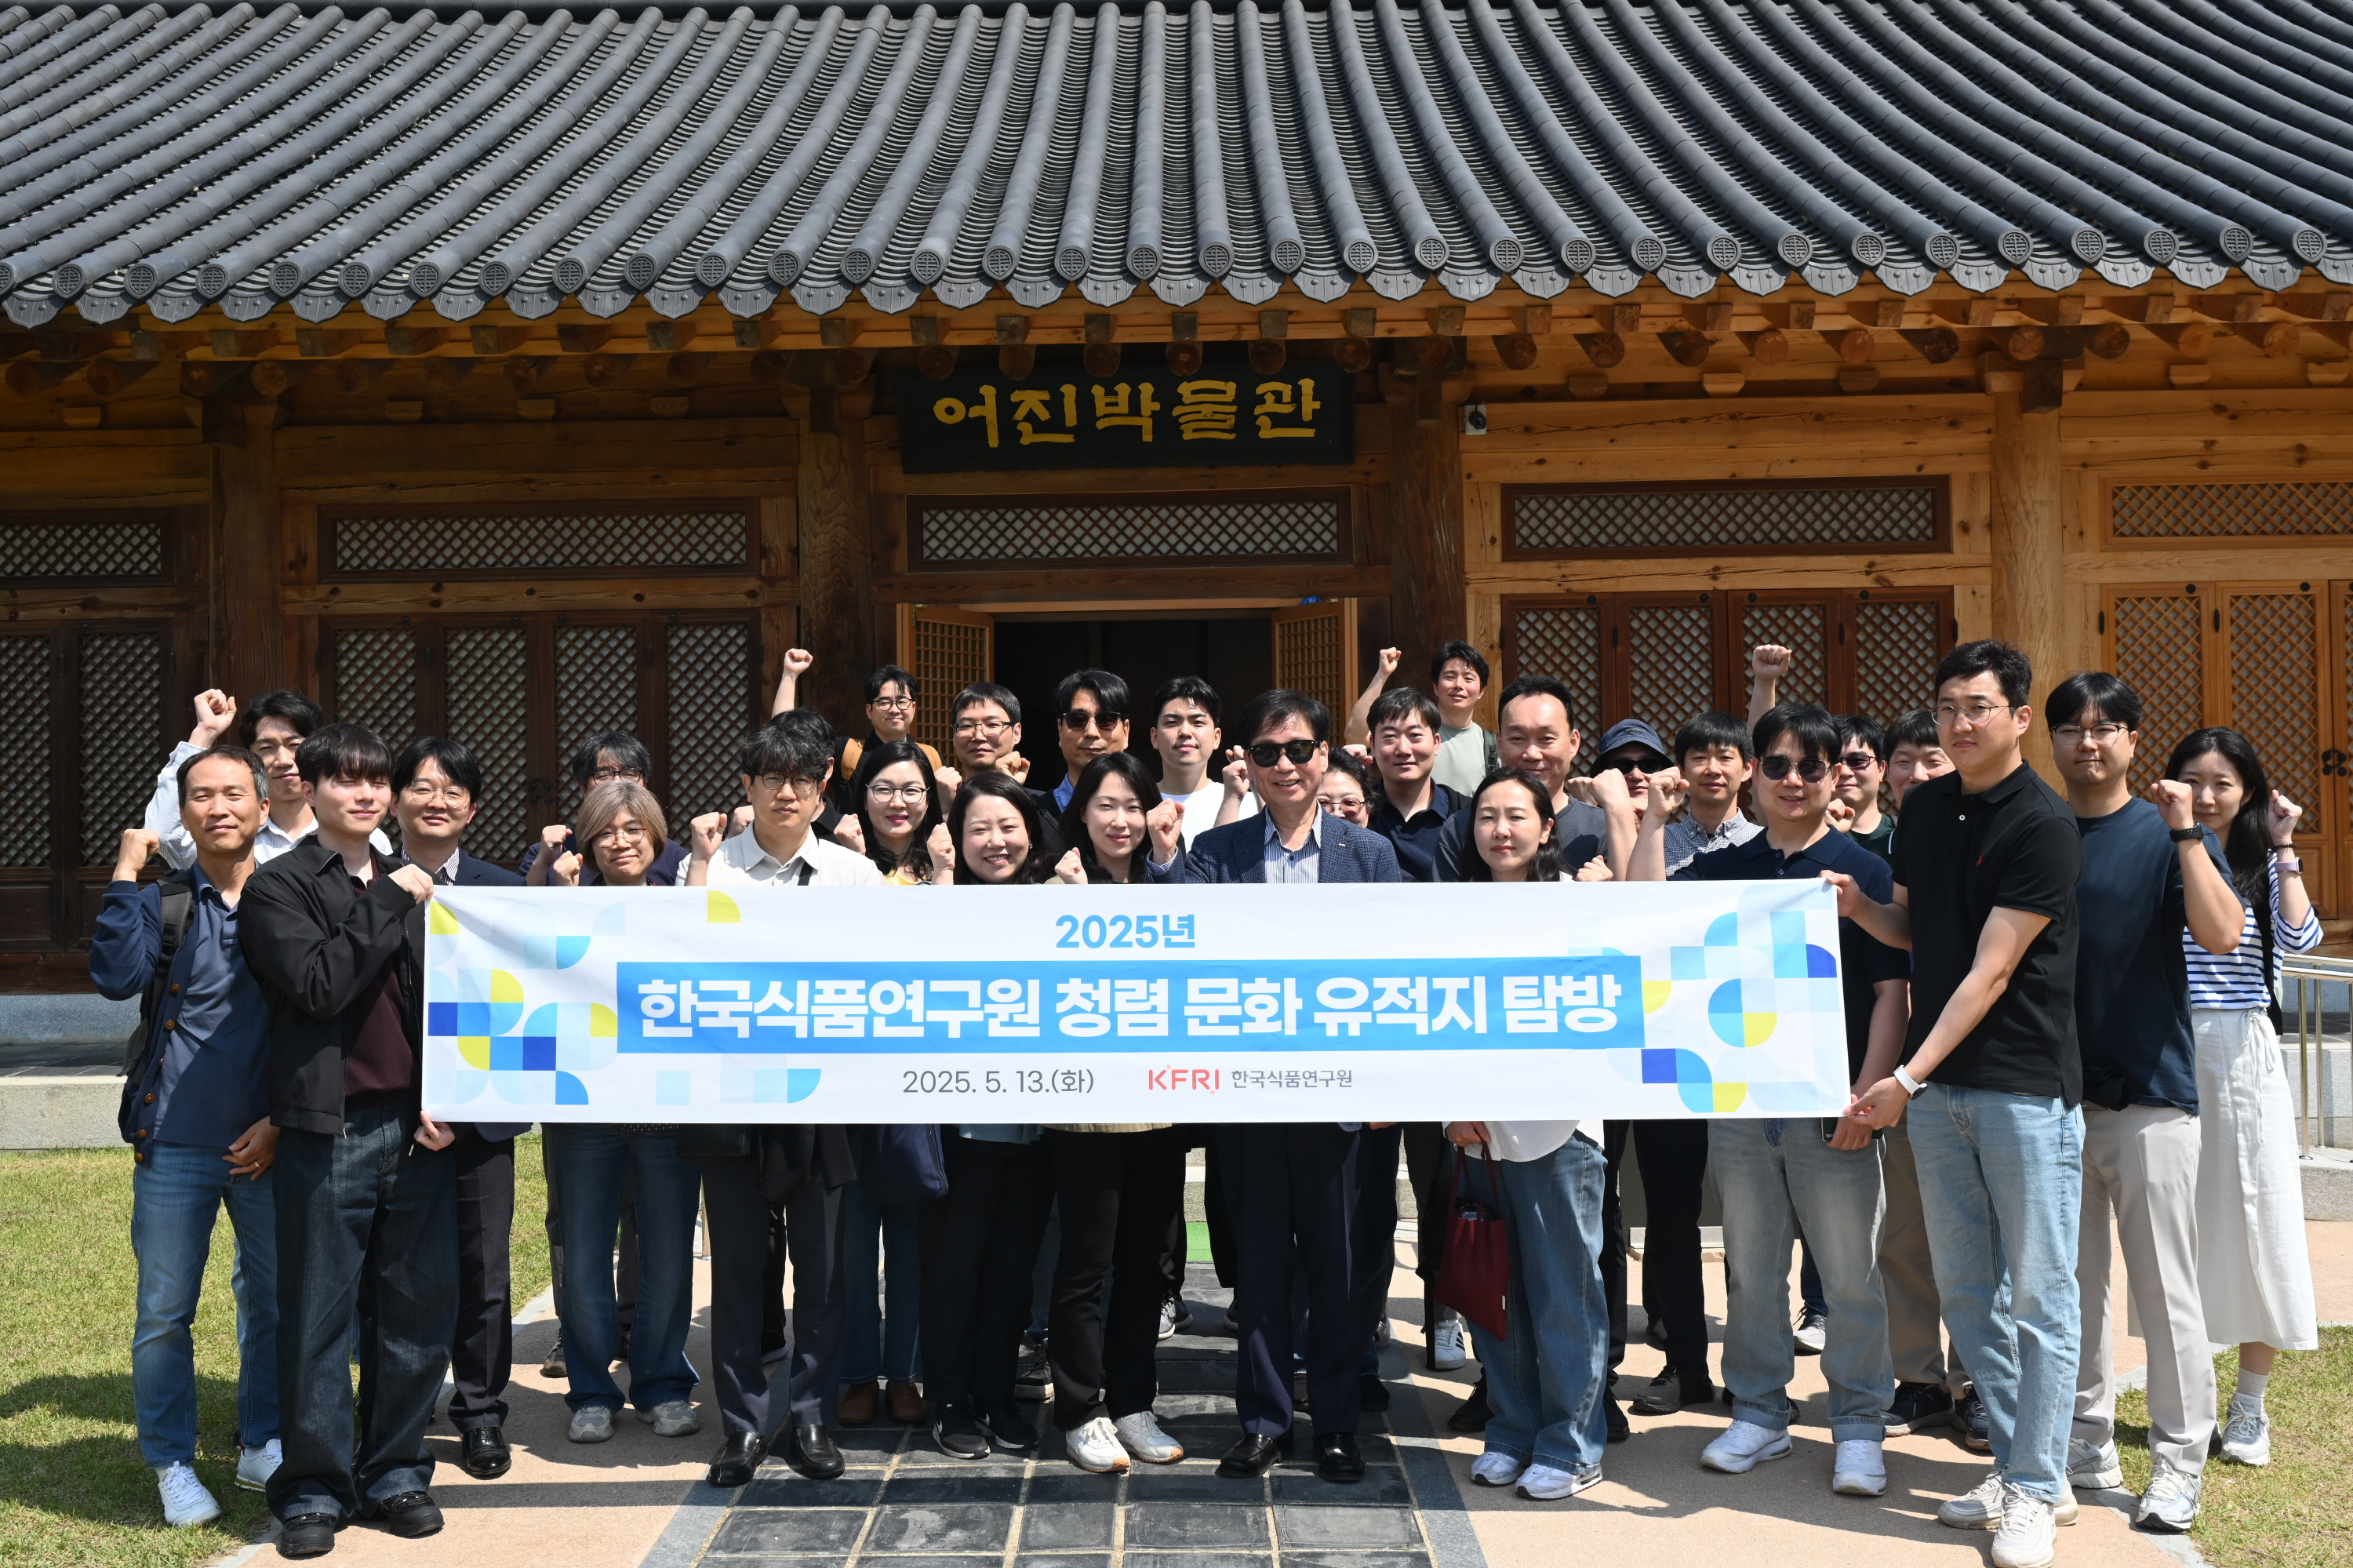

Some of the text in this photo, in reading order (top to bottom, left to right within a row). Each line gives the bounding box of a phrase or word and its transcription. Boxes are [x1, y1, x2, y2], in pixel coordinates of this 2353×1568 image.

[933, 378, 1321, 448] 어진박물관
[1056, 914, 1196, 949] 2025년
[638, 974, 1623, 1039] 한국식품연구원 청렴 문화 유적지 탐방
[903, 1068, 1094, 1094] 2025. 5. 13.(화)
[1148, 1066, 1220, 1093] KFRI
[1231, 1069, 1352, 1089] 한국식품연구원
